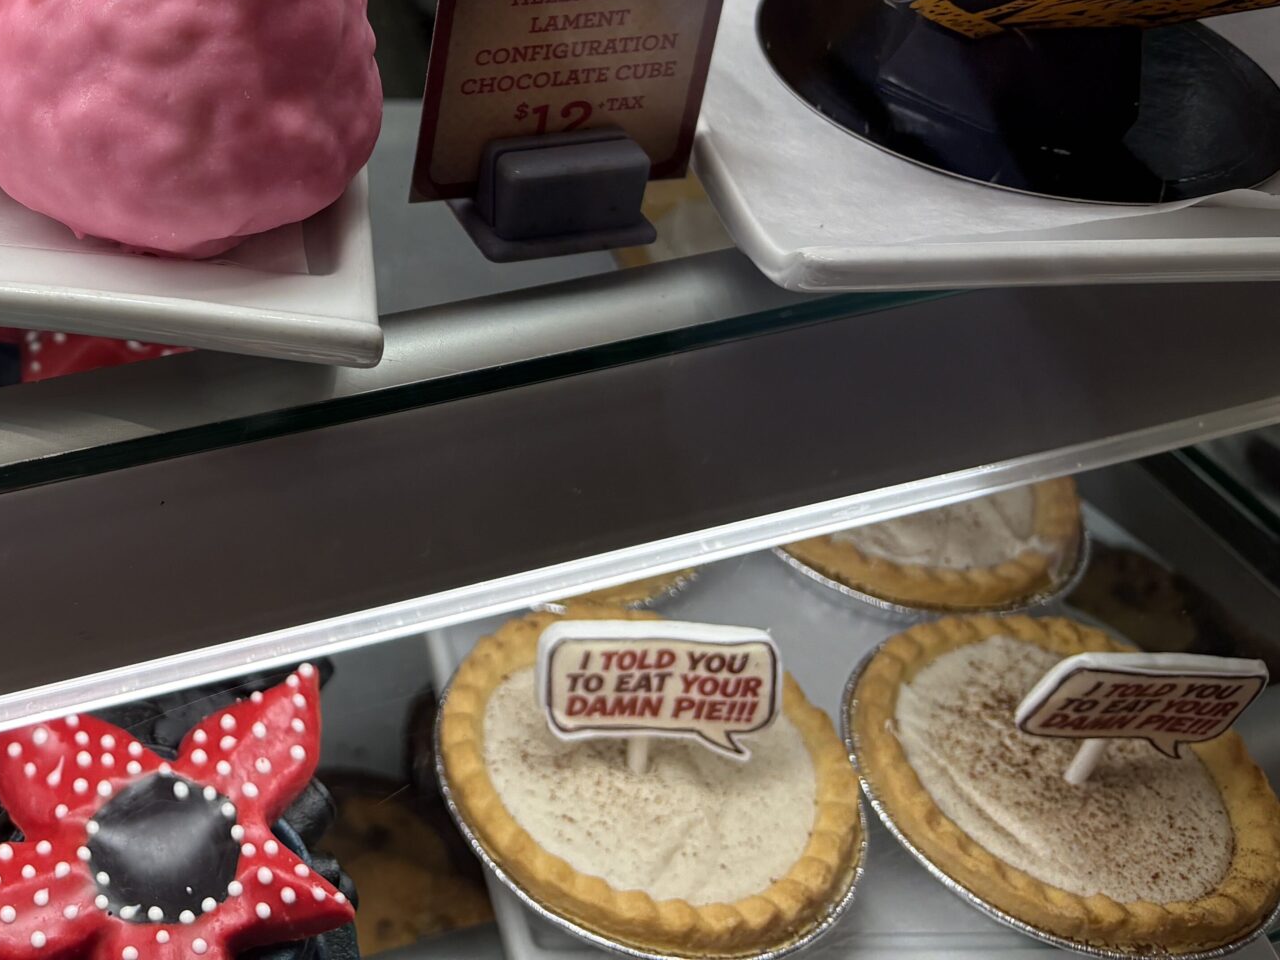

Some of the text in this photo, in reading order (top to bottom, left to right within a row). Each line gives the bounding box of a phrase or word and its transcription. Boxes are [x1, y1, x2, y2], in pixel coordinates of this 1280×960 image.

[528, 9, 631, 34] LAMENT
[475, 33, 679, 66] CONFIGURATION
[460, 61, 678, 95] CHOCOLATE CUBE
[579, 649, 750, 675] I TOLD YOU
[566, 672, 763, 699] TO EAT YOUR
[1082, 681, 1244, 701] I TOLD YOU
[565, 695, 760, 724] DAMN PIE!!!
[1056, 697, 1241, 718] TO EAT YOUR
[1038, 712, 1224, 736] DAMN PIE!!!
